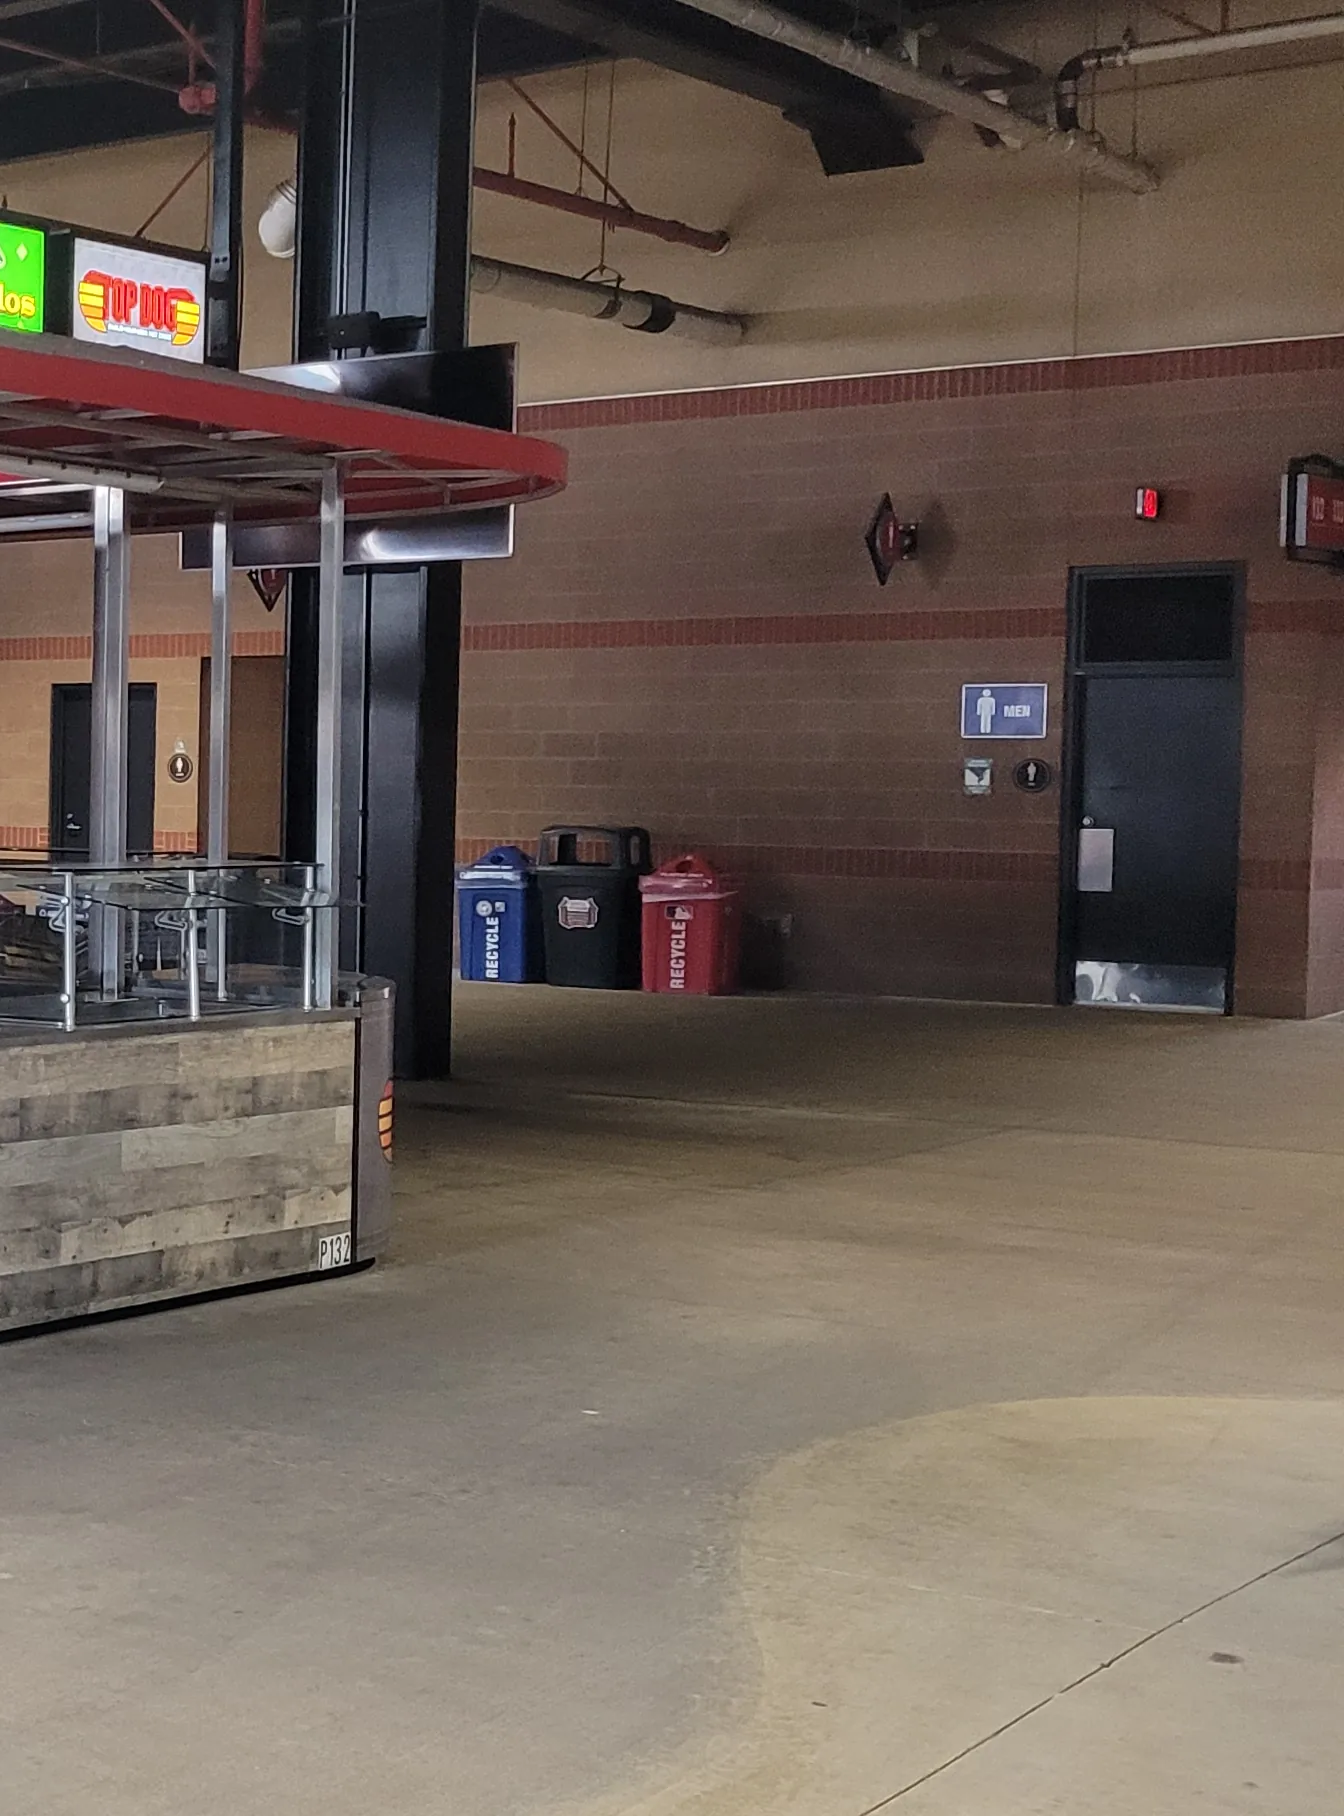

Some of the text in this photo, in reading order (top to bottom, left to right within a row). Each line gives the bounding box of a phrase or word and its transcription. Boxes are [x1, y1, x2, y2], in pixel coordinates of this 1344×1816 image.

[83, 269, 195, 333] TOP DOG
[1003, 705, 1031, 717] MEN
[486, 917, 499, 978] RECYCLE
[670, 921, 686, 989] RECYCLE
[320, 1235, 350, 1269] P132
